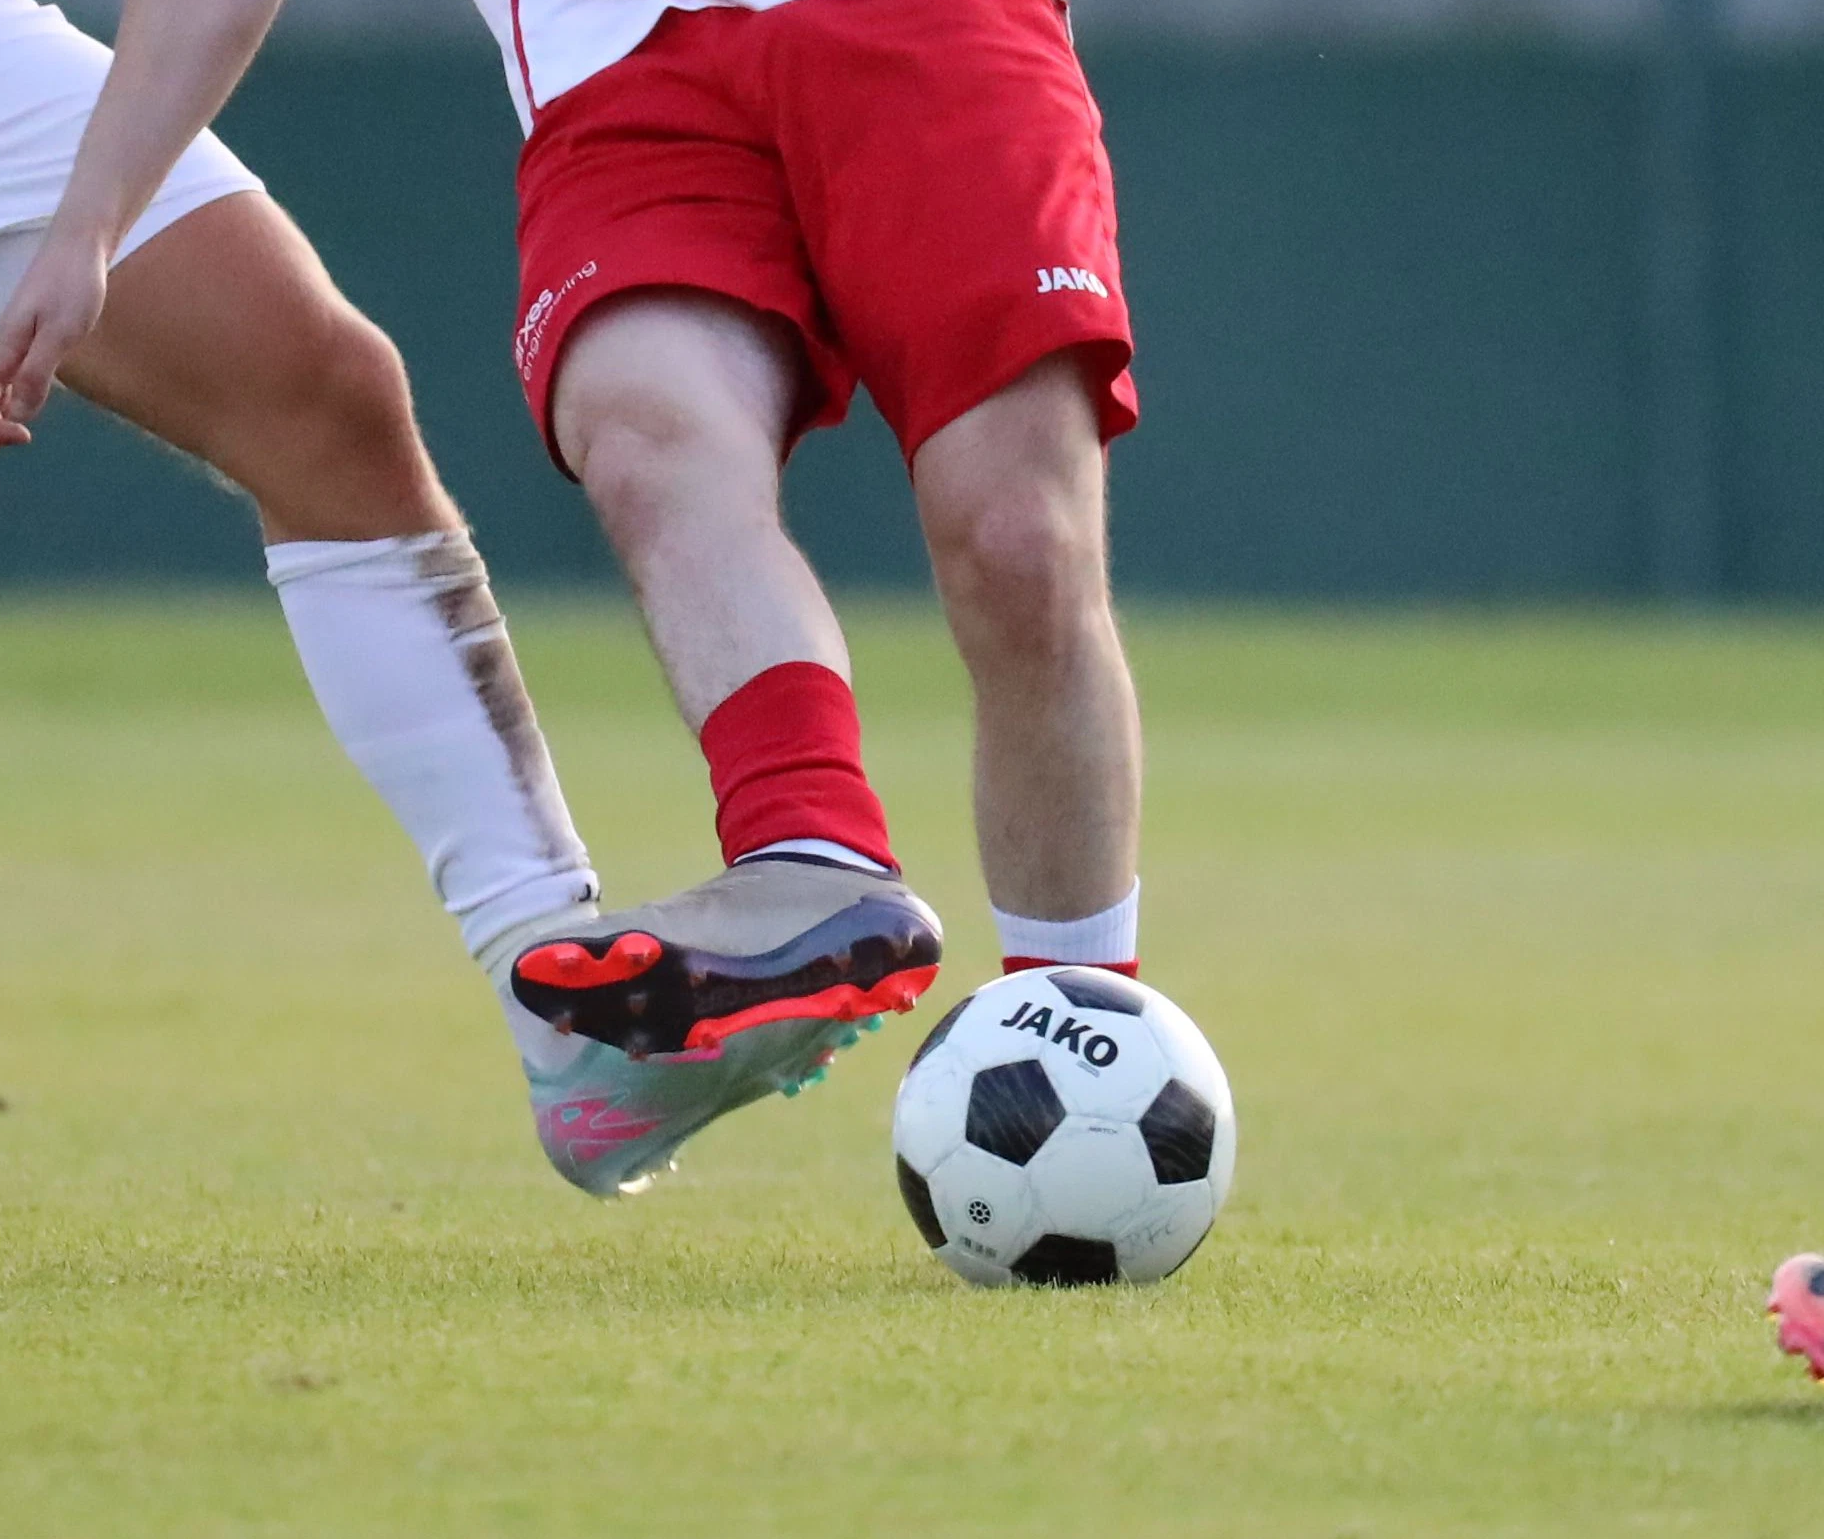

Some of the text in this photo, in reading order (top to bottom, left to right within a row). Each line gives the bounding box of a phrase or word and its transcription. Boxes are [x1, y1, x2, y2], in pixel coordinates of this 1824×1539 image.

[1036, 266, 1109, 299] JAKO
[522, 260, 598, 382] engineering
[1000, 1001, 1119, 1068] JAKO
